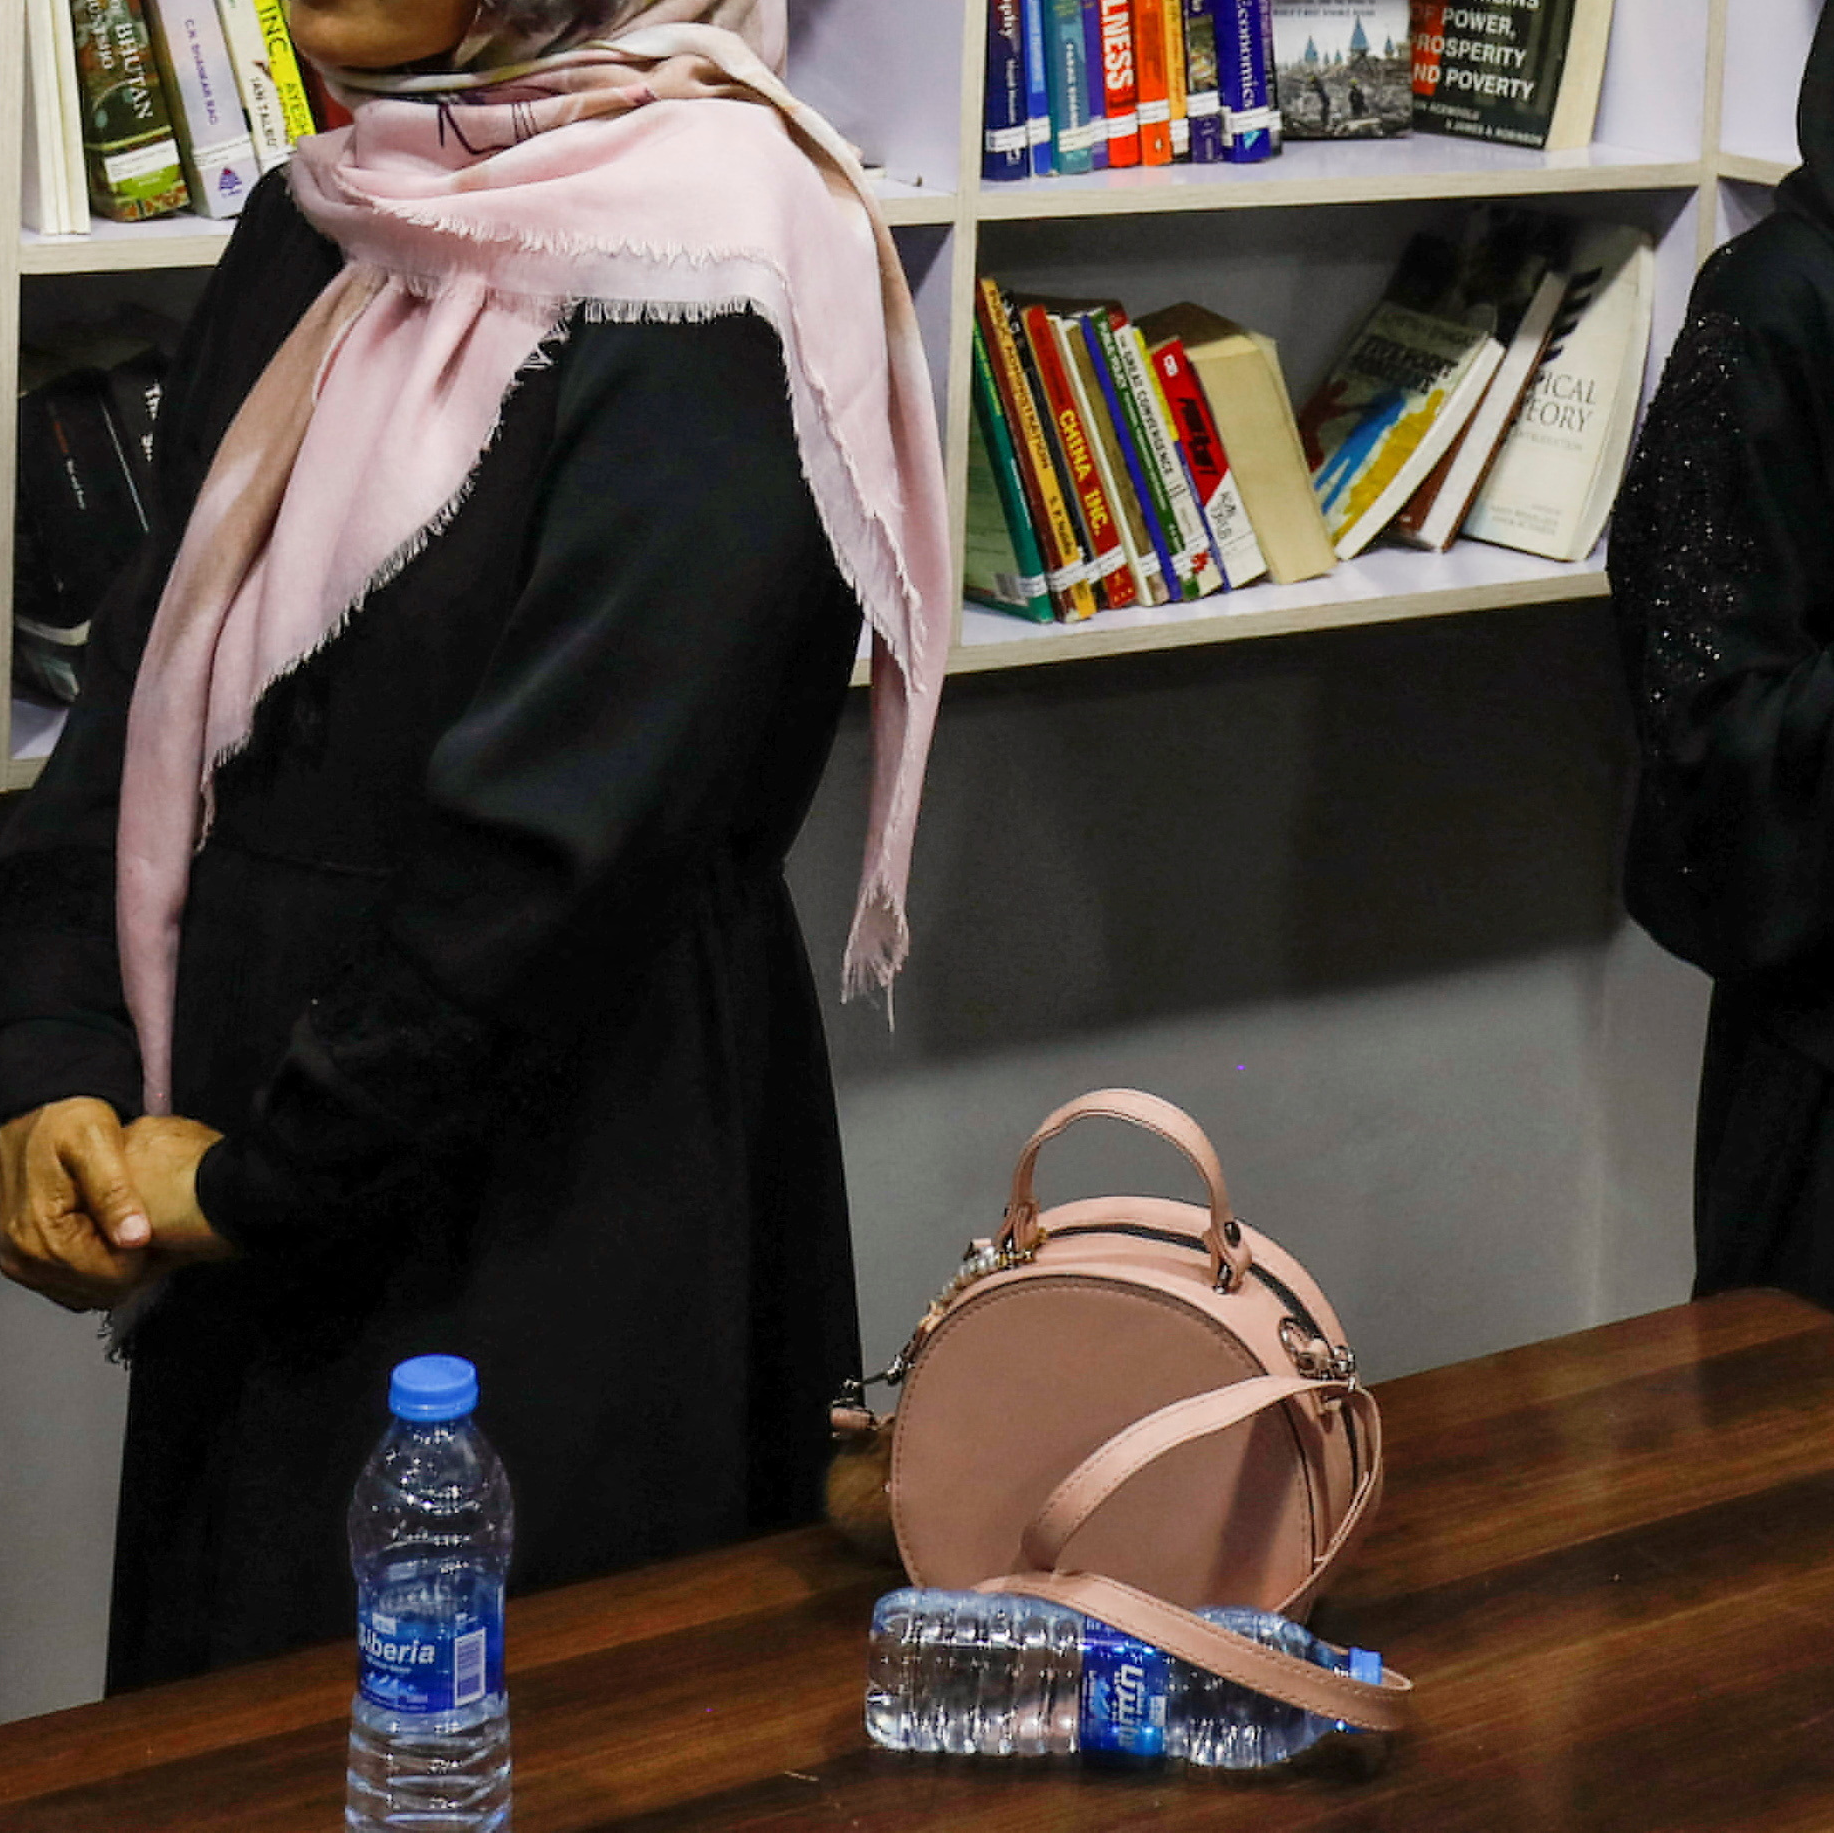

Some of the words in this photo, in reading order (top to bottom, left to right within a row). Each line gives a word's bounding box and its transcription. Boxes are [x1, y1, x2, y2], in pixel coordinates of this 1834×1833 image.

[1442, 8, 1517, 39] POWER,
[113, 20, 155, 121] BHUTAN
[1445, 69, 1535, 102] POVERTY
[1058, 409, 1094, 481] CHINA
